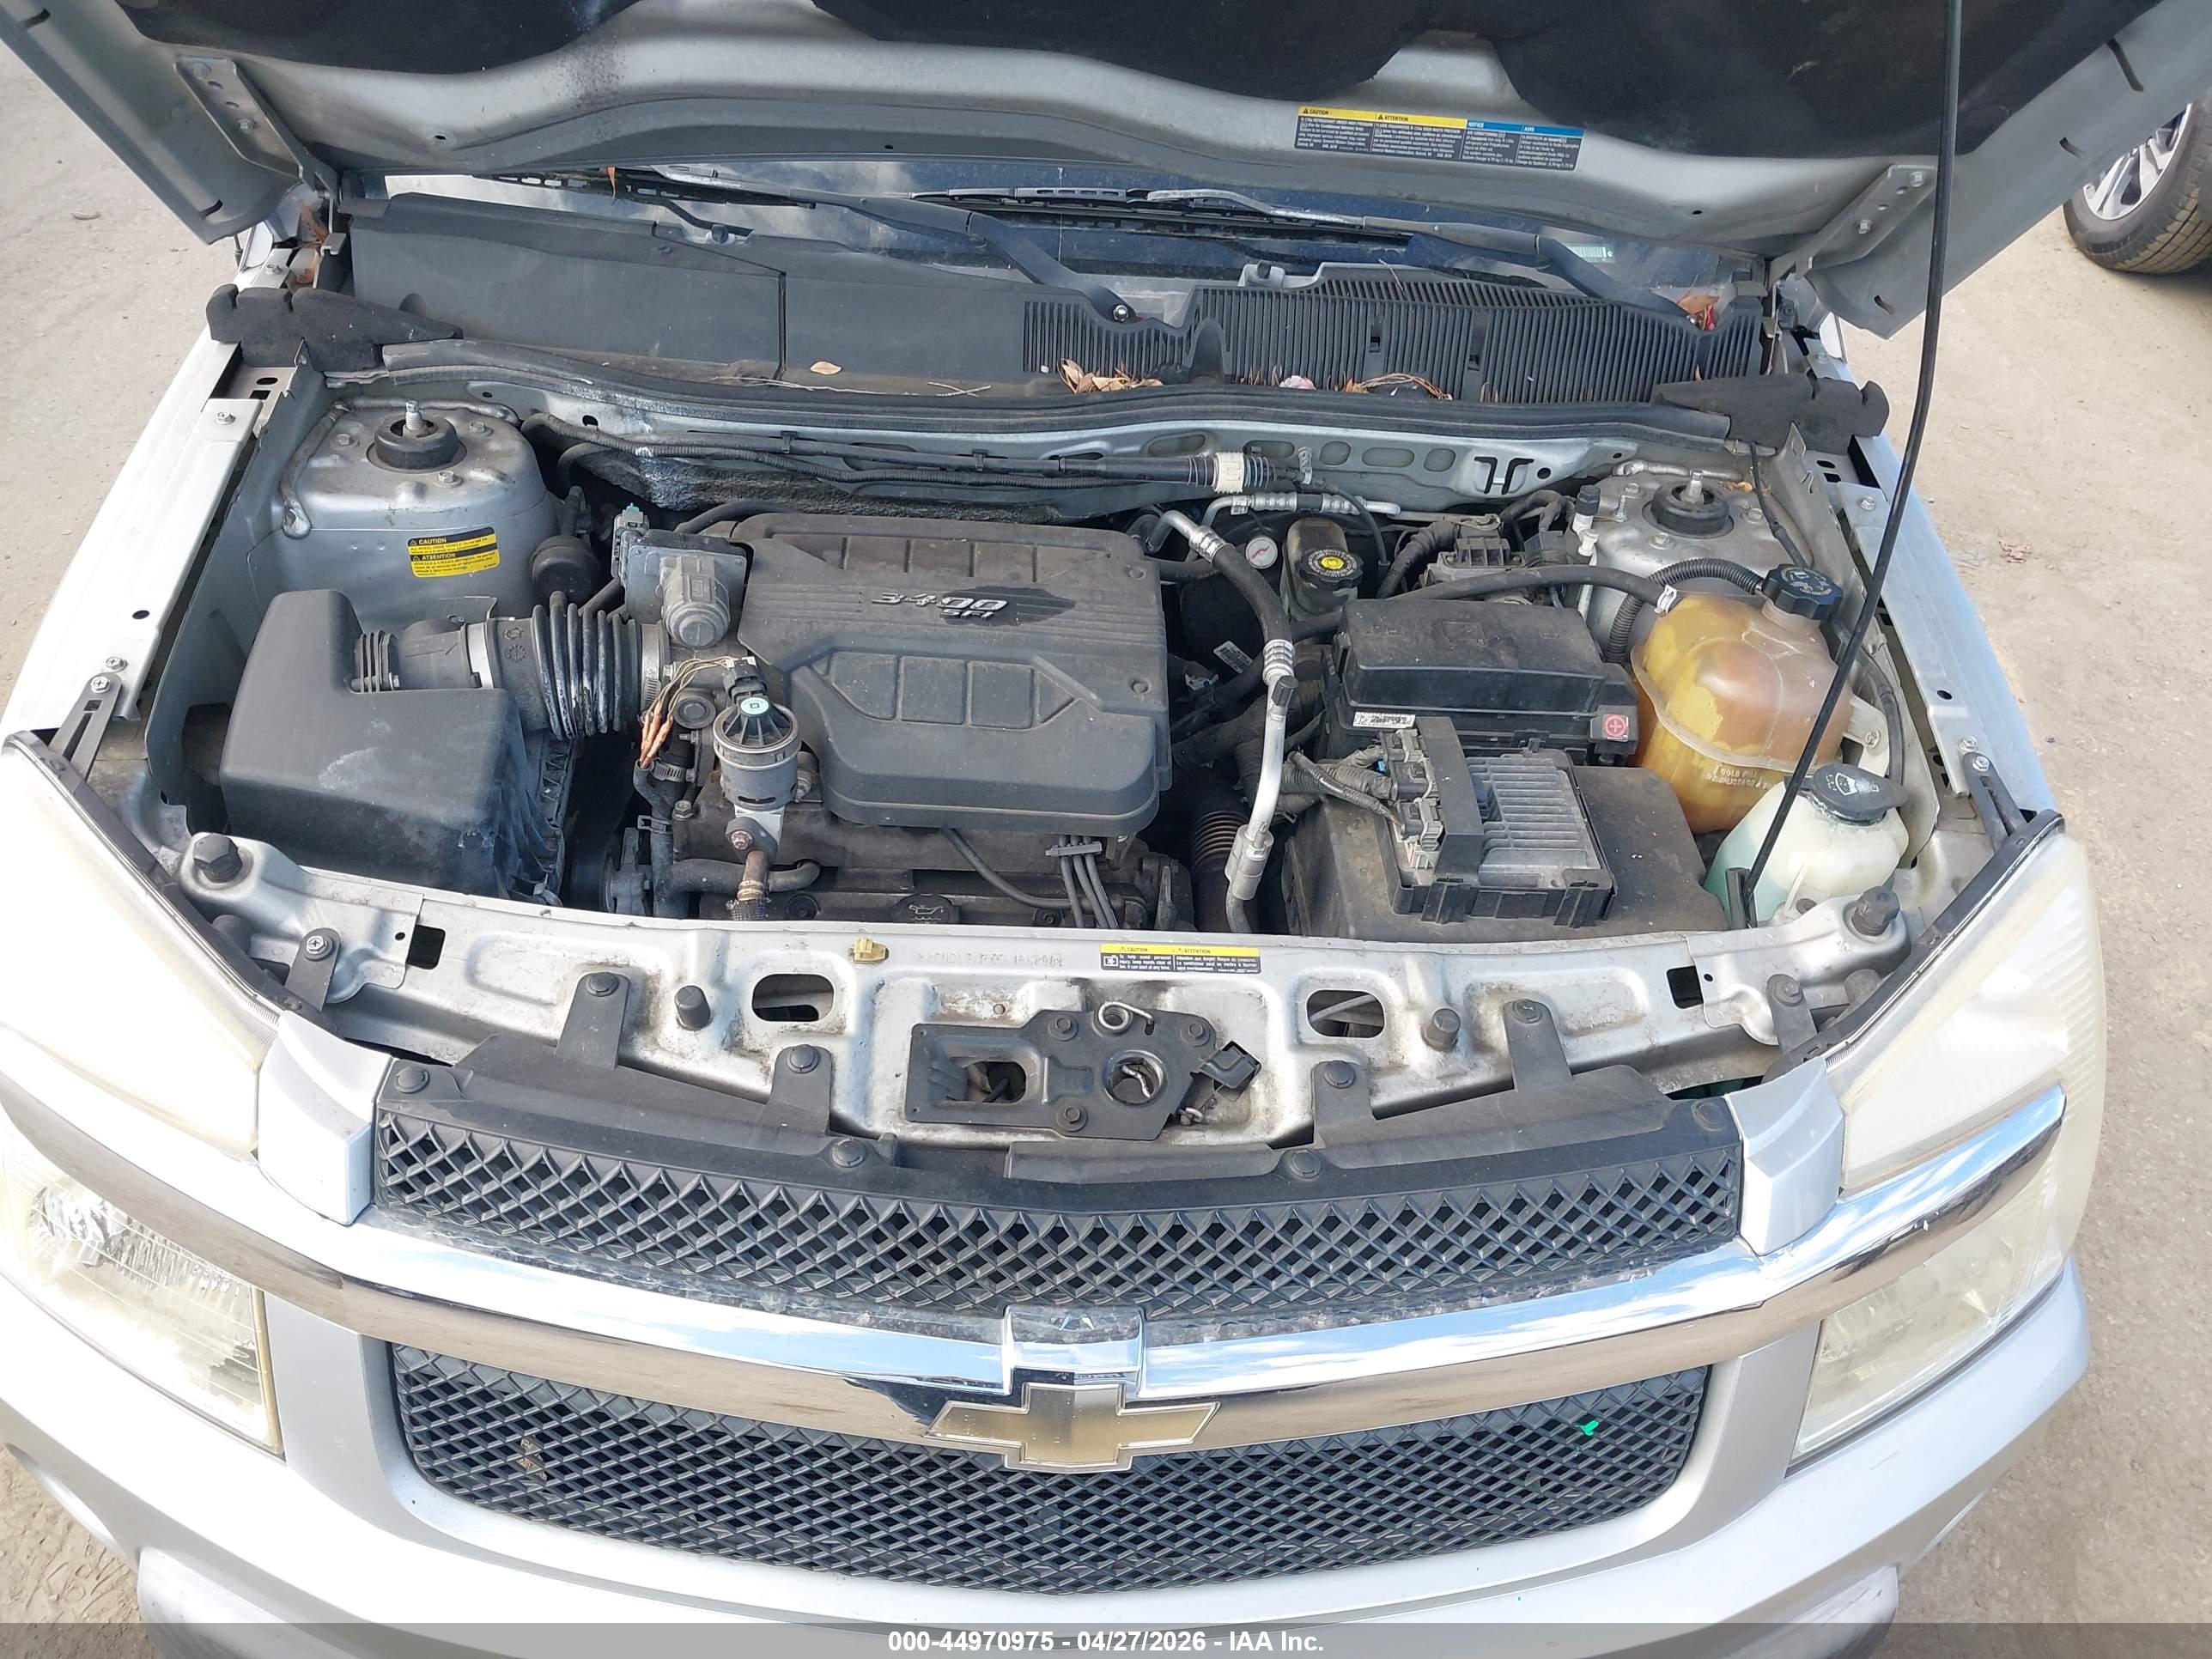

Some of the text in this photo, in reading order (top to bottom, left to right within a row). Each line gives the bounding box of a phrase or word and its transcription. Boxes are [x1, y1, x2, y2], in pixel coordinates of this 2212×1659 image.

[419, 537, 447, 545] CAUTION
[422, 552, 456, 561] ATTENTION
[872, 592, 1009, 611] 3400
[940, 608, 994, 620] SFI
